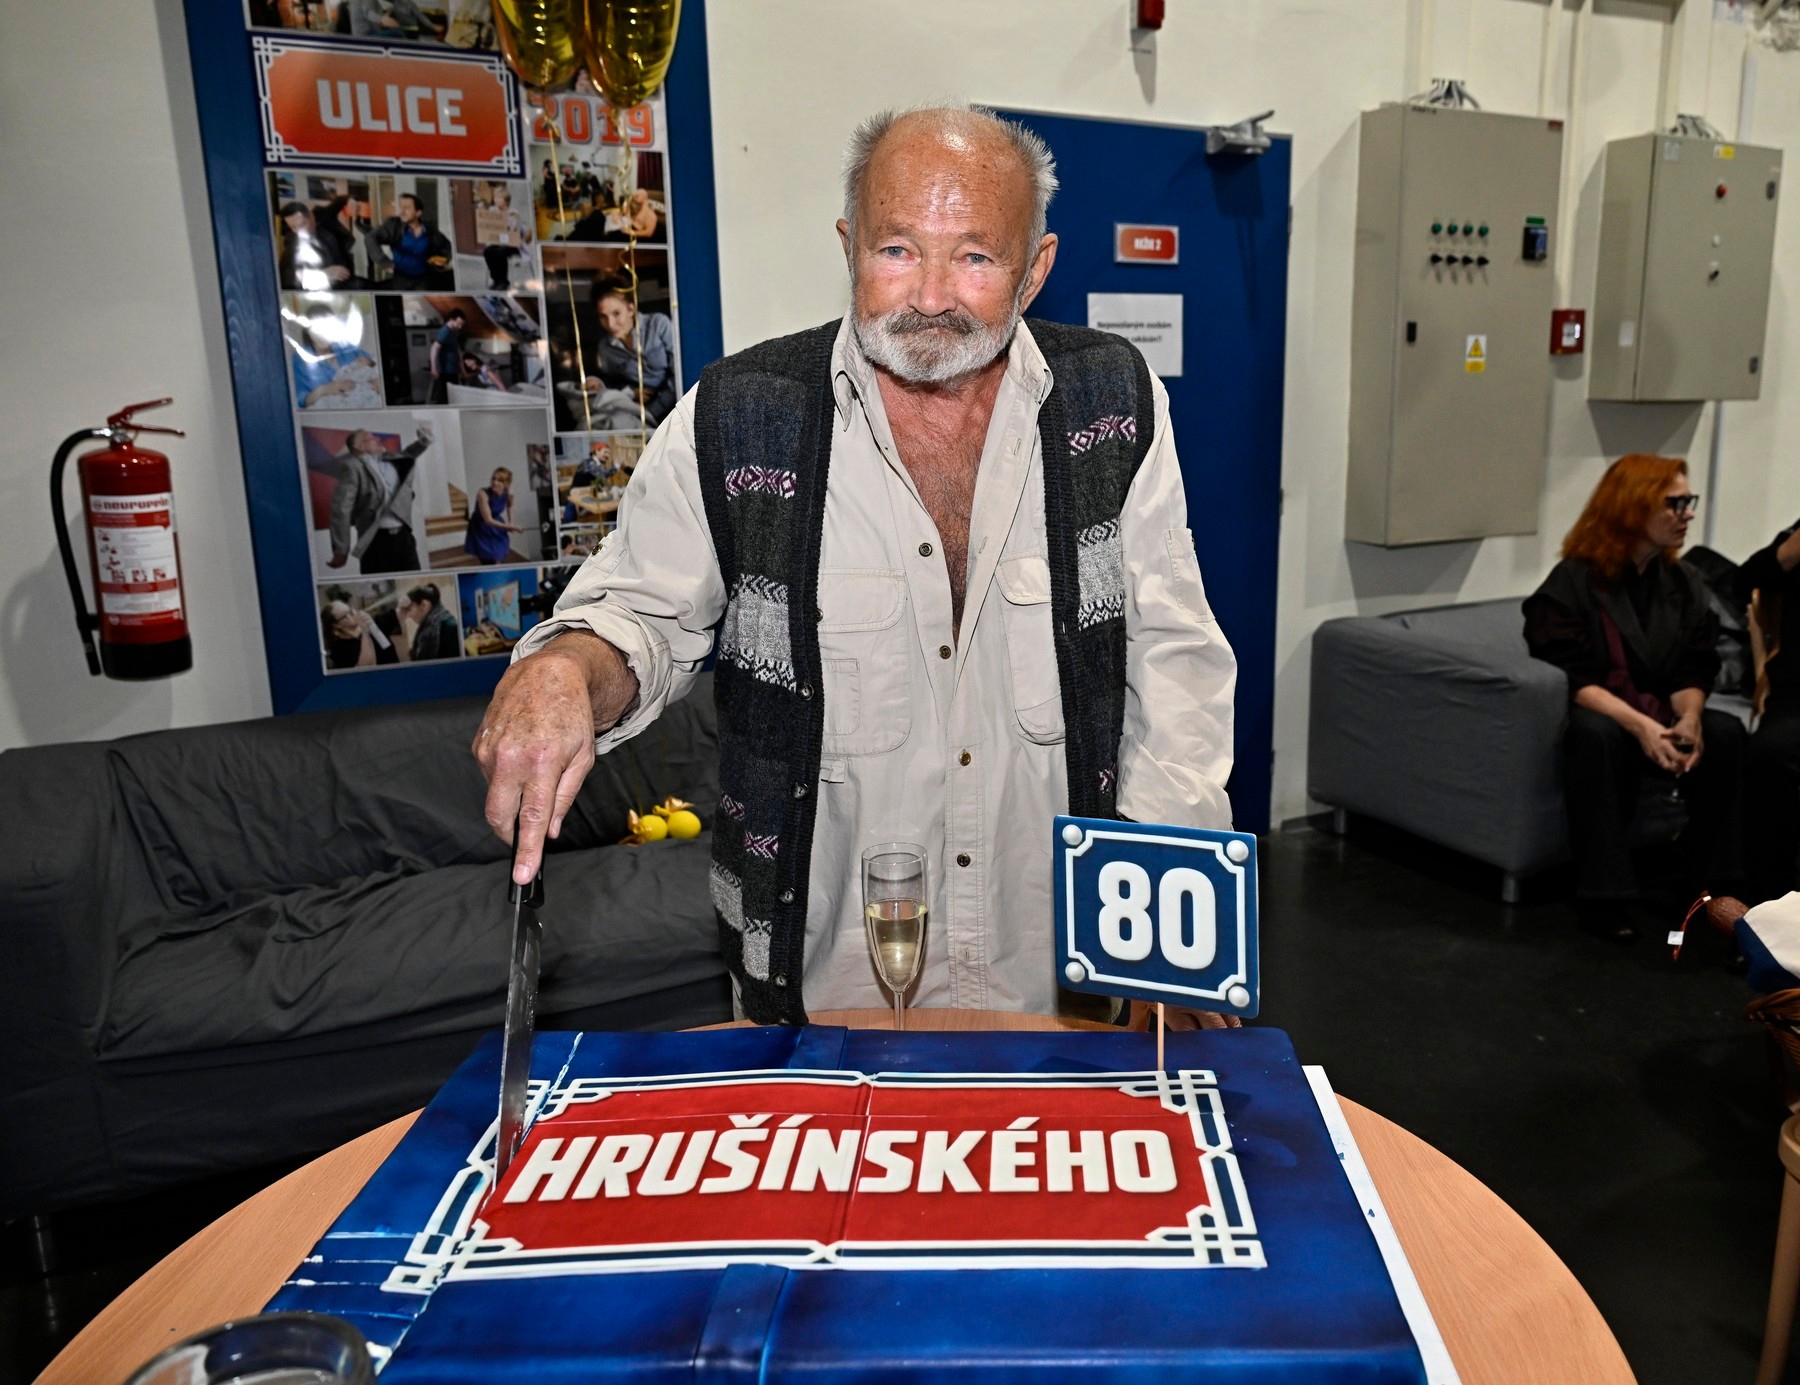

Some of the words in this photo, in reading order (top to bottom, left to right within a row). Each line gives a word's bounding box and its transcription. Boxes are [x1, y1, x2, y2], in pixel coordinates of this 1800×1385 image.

[316, 78, 468, 137] ULICE
[527, 91, 654, 147] 2019
[1098, 860, 1217, 970] 80
[501, 1113, 1179, 1204] HRUŠÍNSKÉHO
